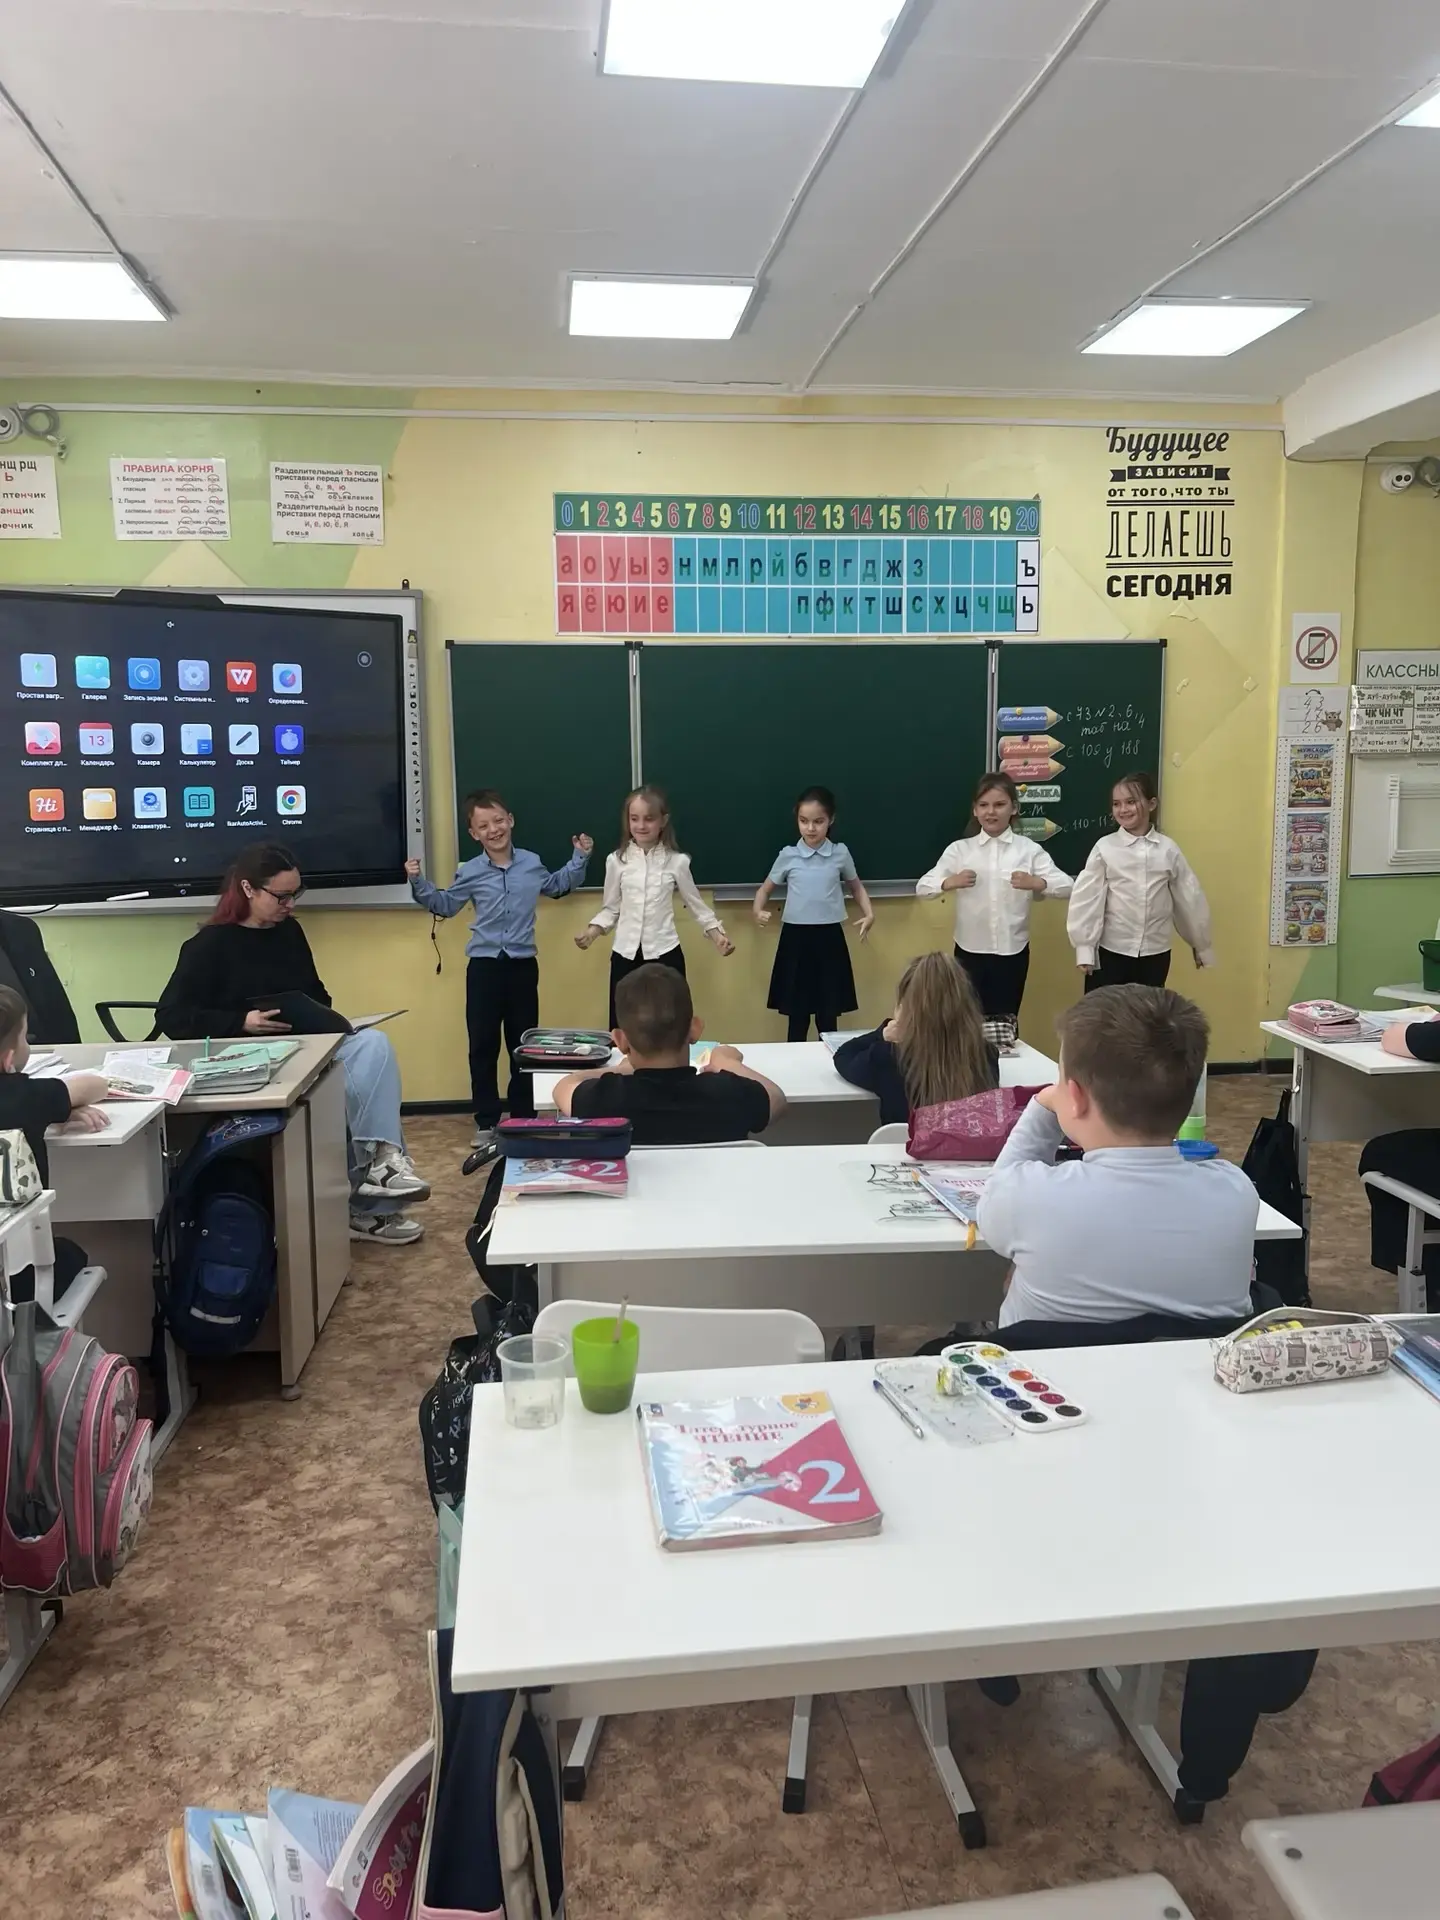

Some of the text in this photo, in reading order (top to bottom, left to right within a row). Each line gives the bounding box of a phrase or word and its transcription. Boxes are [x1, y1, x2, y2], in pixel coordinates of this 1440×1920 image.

[1106, 427, 1229, 461] Будущее
[123, 464, 214, 473] ПРАВИЛА КОРНЯ
[275, 466, 343, 476] Разделительный
[1135, 467, 1208, 477] ЗАВИСИТ
[316, 475, 340, 483] перед
[276, 502, 346, 512] Разделительный
[561, 500, 1038, 531] 0 1 2 3 4 5 6 7 8 9 10 11 12 13 14 15 16 17 18 19 20
[1105, 510, 1232, 559] ДЕЛАЕШЬ
[561, 556, 573, 575] а
[584, 557, 597, 575] о
[608, 556, 621, 581] у
[630, 557, 647, 576] ы
[657, 556, 670, 576] э
[679, 558, 691, 576] н
[703, 558, 717, 576] м
[725, 558, 739, 577] л
[750, 558, 762, 583] р
[772, 552, 784, 577] й
[795, 552, 808, 577] б
[819, 559, 831, 577] в
[843, 559, 852, 577] г
[862, 560, 877, 582] д
[886, 560, 902, 578] ж
[913, 559, 924, 577] з
[1106, 574, 1232, 600] СЕГОДНЯ
[562, 595, 574, 613] я
[584, 588, 597, 613] ё
[607, 595, 625, 613] ю
[634, 595, 647, 613] и
[657, 595, 669, 613] е
[797, 596, 809, 614] п
[816, 590, 834, 621] ф
[843, 597, 853, 614] к
[865, 597, 876, 614] т
[886, 597, 902, 615] ш
[911, 595, 923, 614] с
[934, 595, 945, 614] х
[955, 596, 967, 618] ц
[978, 596, 989, 614] ч
[998, 596, 1014, 617] щ
[1367, 664, 1439, 678] КЛАССНЫ
[1365, 708, 1405, 717] ЧК ЧН ЧТ
[88, 735, 105, 746] 13
[1121, 739, 1141, 755] 188
[180, 759, 216, 767] Калькулятор
[590, 1161, 621, 1177] 2
[693, 1431, 784, 1444] ЧТЕНИЕ
[797, 1460, 861, 1504] 2
